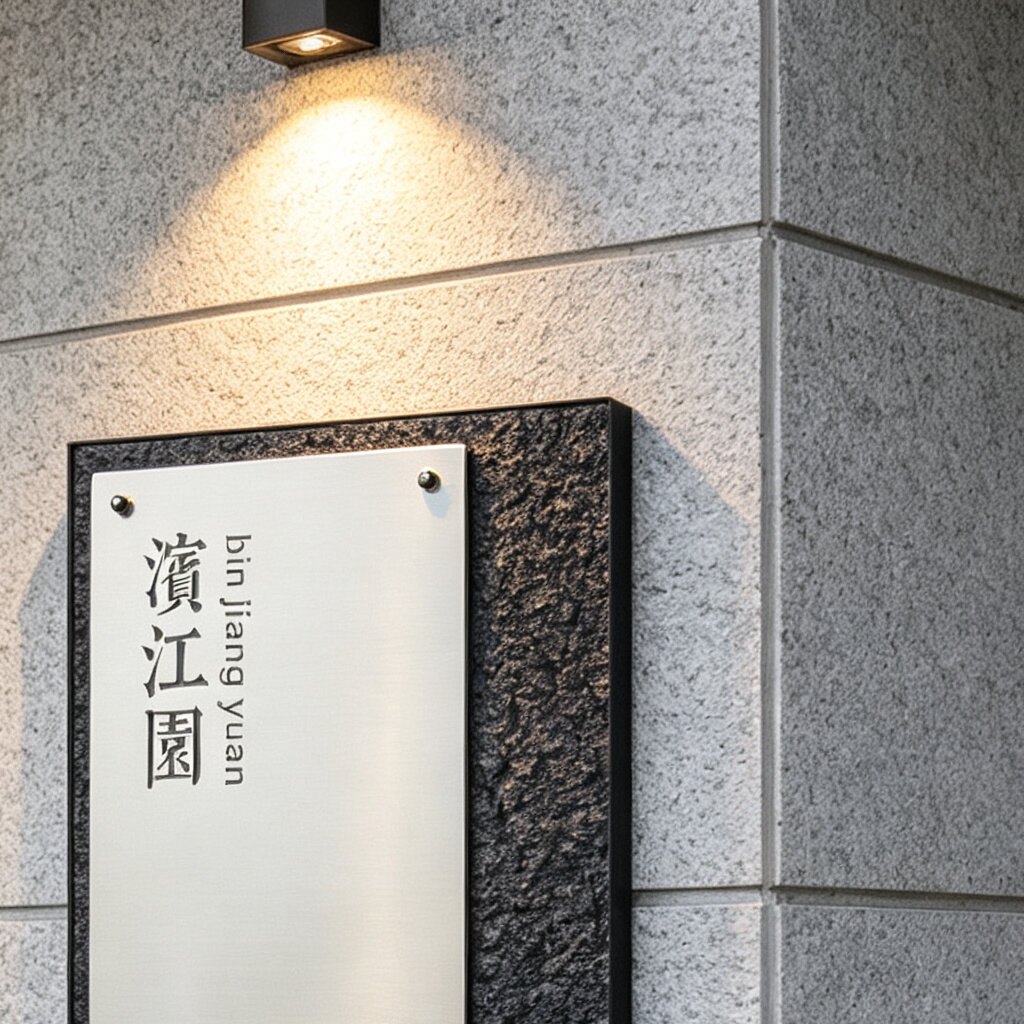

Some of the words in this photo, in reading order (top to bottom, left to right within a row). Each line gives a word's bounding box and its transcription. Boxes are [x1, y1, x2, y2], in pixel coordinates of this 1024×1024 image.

[225, 535, 252, 587] bin
[142, 532, 209, 789] 濱江園
[219, 597, 252, 687] jiang
[217, 698, 245, 786] yuan
